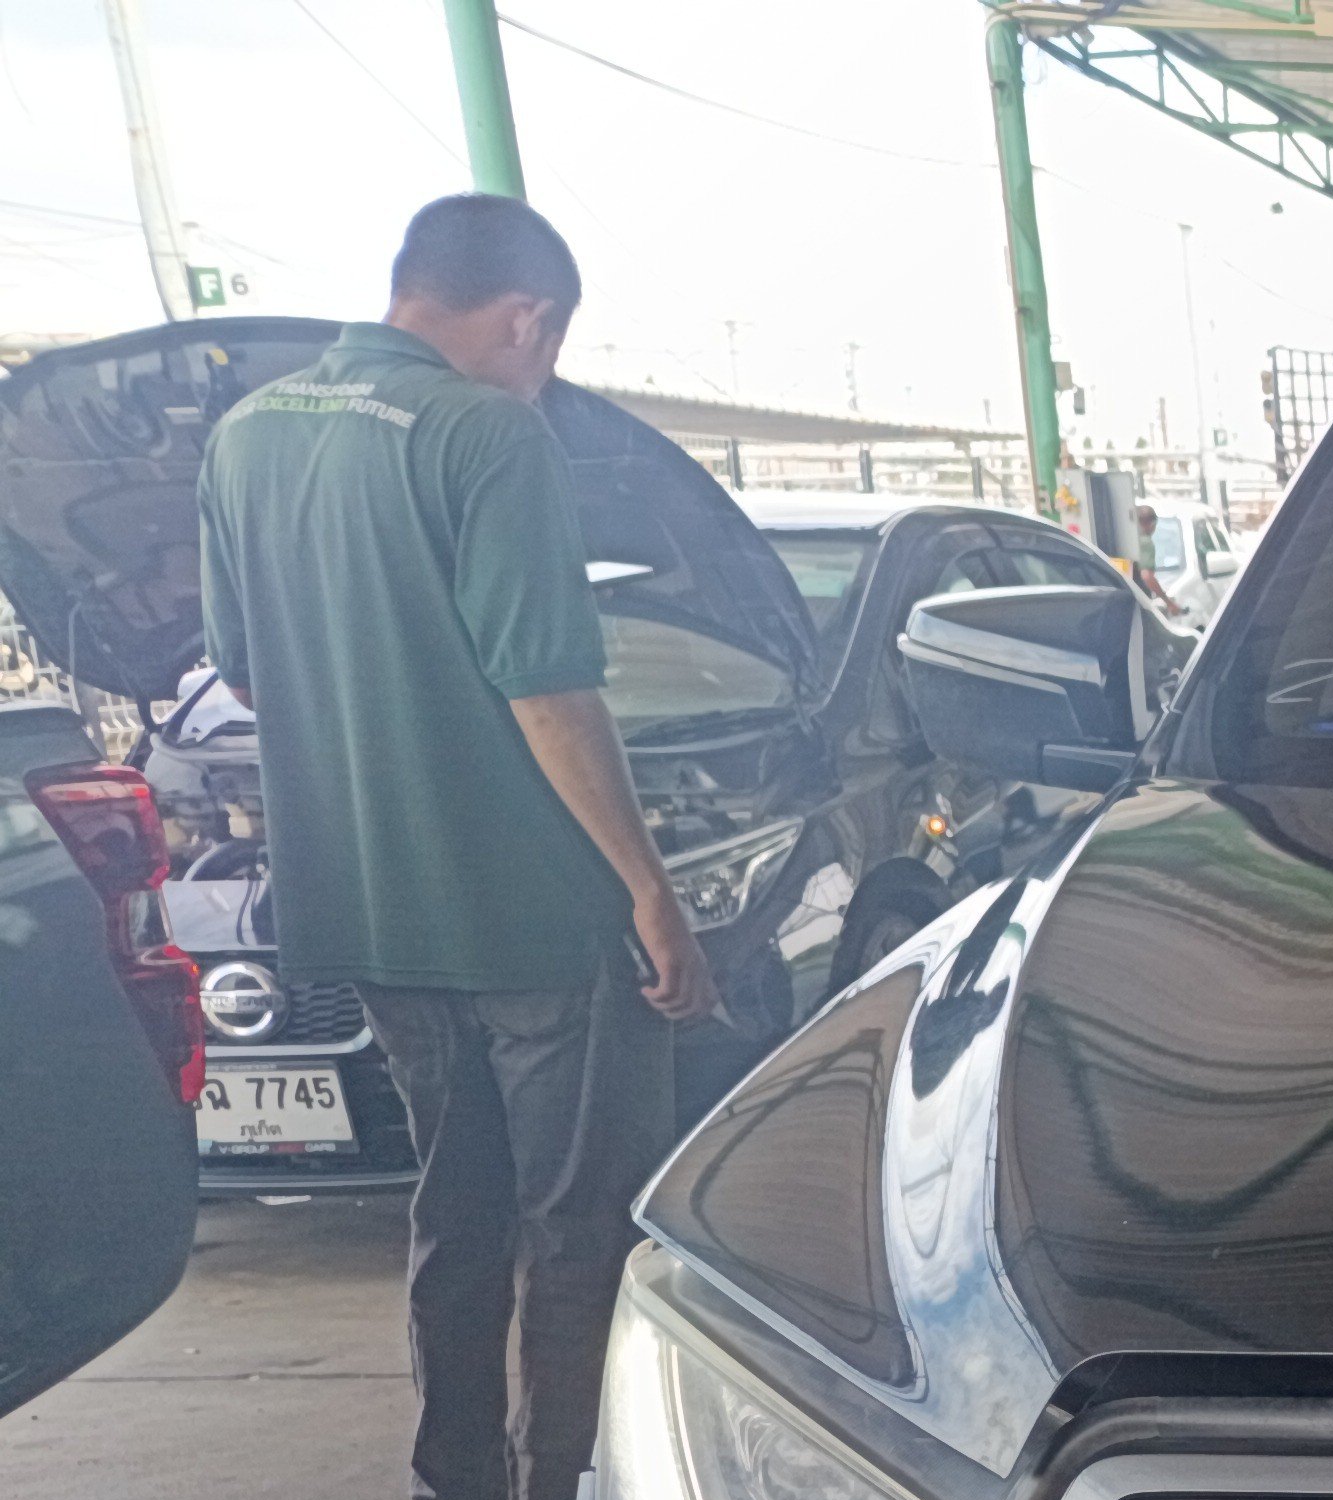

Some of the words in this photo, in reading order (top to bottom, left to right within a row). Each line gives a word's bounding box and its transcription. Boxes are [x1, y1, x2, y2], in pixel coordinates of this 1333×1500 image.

[199, 273, 218, 299] F
[231, 273, 249, 296] 6
[257, 396, 346, 413] EXCELLENT
[346, 397, 417, 429] FUTURE
[245, 1077, 336, 1109] 7745
